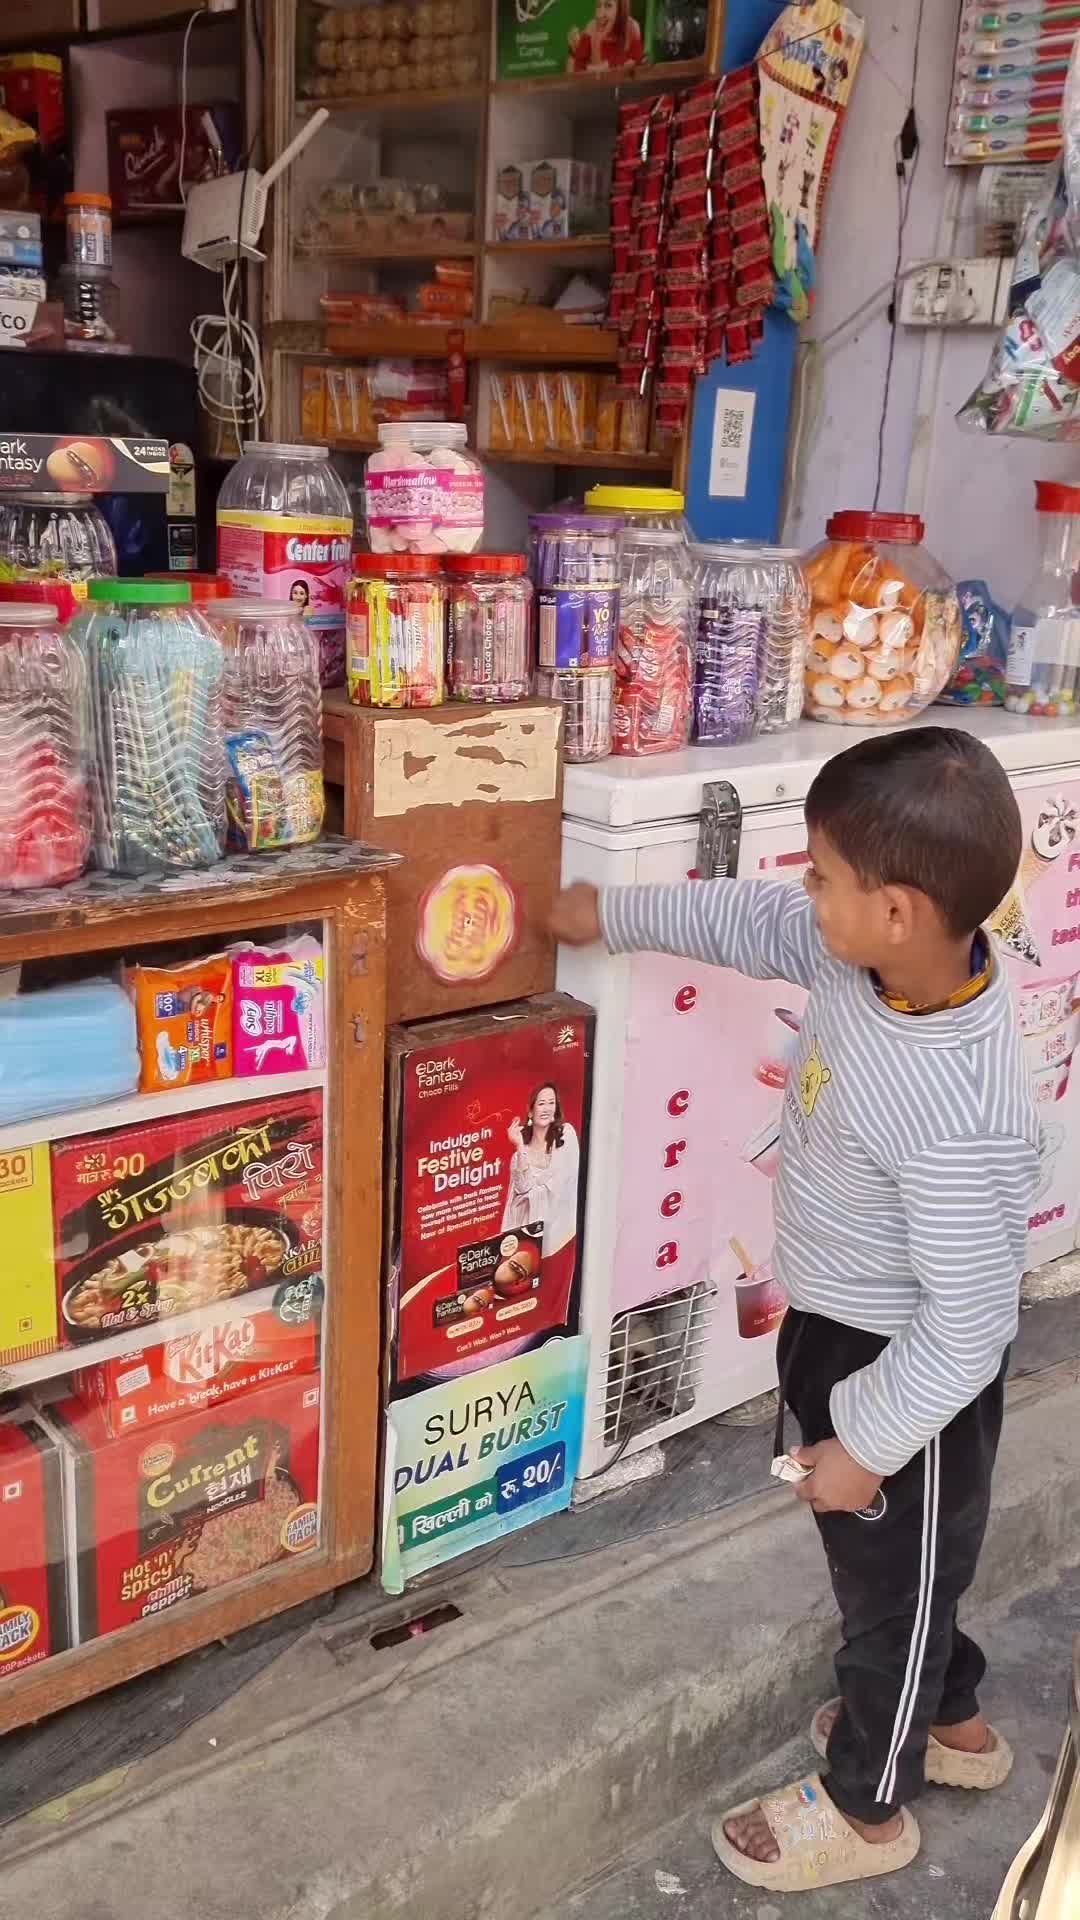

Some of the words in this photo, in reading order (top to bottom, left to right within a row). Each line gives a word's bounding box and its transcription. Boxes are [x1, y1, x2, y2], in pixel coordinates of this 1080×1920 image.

[133, 446, 146, 456] 24
[286, 537, 330, 562] Center
[197, 1018, 213, 1061] whisper
[418, 1068, 466, 1088] Fantasy
[418, 1087, 443, 1098] Choco
[444, 1084, 458, 1093] Fills
[430, 1131, 479, 1154] Indulge
[481, 1127, 492, 1140] in
[0, 1154, 26, 1179] 30
[417, 1147, 484, 1178] Festive
[434, 1157, 501, 1193] Delight
[417, 1200, 449, 1214] Celebrate
[463, 1191, 478, 1200] Dark
[435, 1207, 452, 1218] more
[420, 1217, 445, 1229] yourself
[446, 1213, 457, 1221] this
[457, 1207, 477, 1218] festive
[420, 1230, 437, 1241] Now
[437, 1226, 446, 1235] at
[446, 1219, 472, 1233] Special
[461, 1254, 499, 1273] Fantasy
[102, 1311, 125, 1328] Hot
[140, 1298, 175, 1321] Spicy
[436, 1305, 463, 1318] Fantasy
[148, 1400, 176, 1416] Have
[177, 1398, 185, 1408] a
[223, 1377, 247, 1392] have
[248, 1375, 256, 1384] a
[258, 1359, 297, 1381] KitKat
[424, 1380, 536, 1446] SURYA
[394, 1442, 469, 1495] DUAL
[477, 1400, 568, 1461] BURST
[147, 1434, 259, 1508] Current
[204, 1464, 252, 1502] 현재
[206, 1491, 247, 1514] NOODLES
[474, 1491, 493, 1511] को
[287, 1522, 318, 1546] PACK
